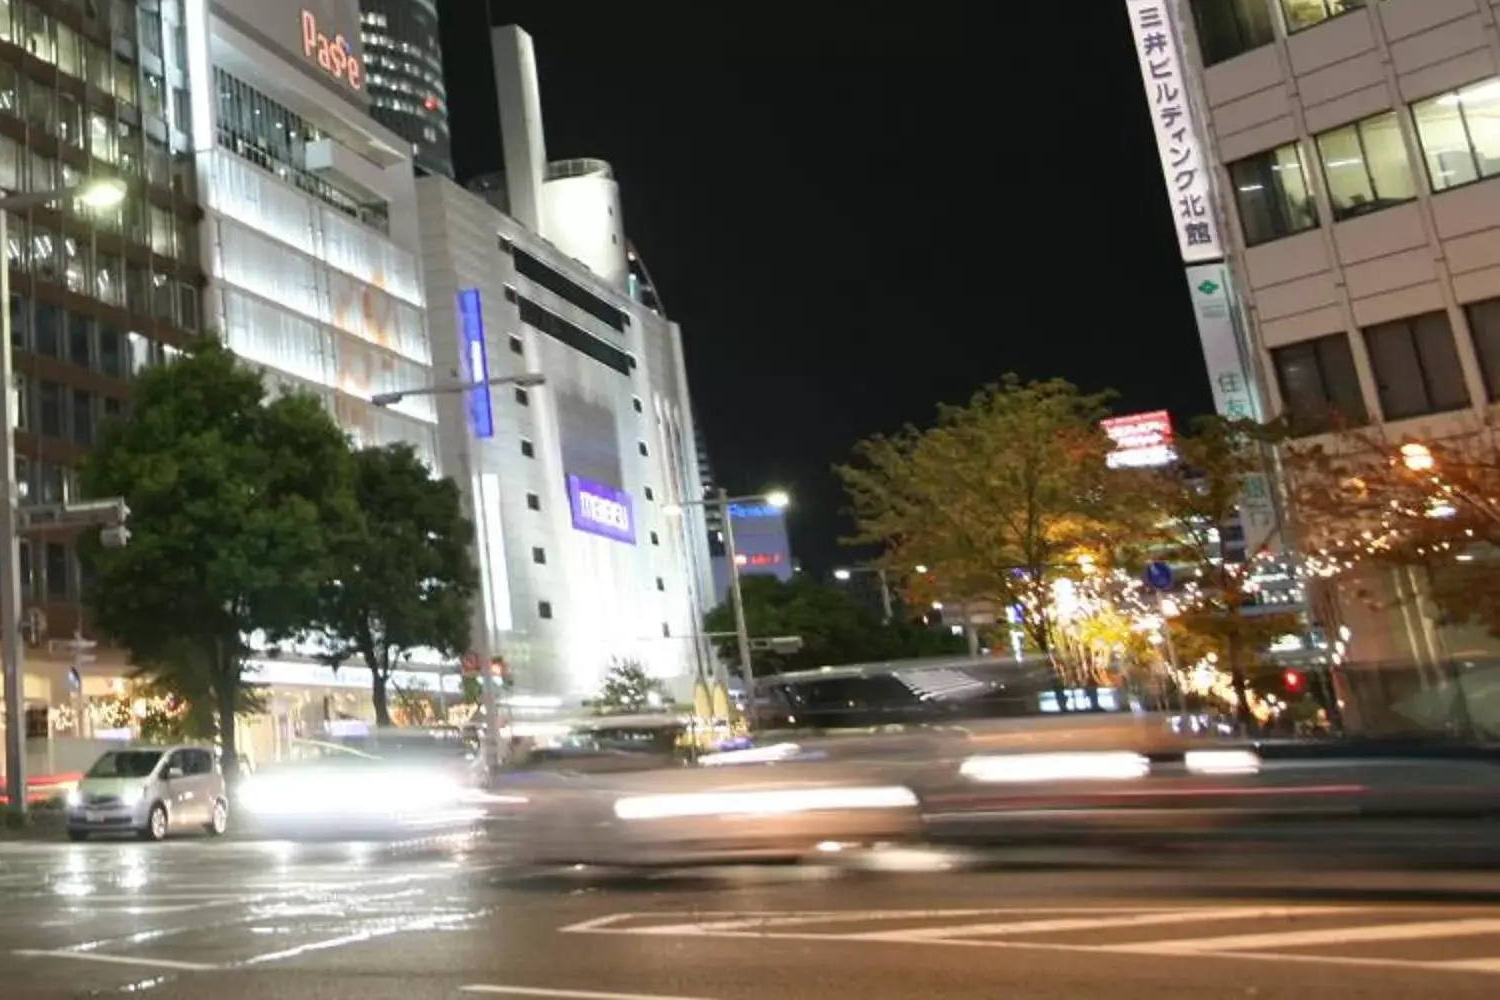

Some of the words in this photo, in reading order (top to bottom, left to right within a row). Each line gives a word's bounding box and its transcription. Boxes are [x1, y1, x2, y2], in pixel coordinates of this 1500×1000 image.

[1138, 5, 1213, 246] 三井ビルディング北館
